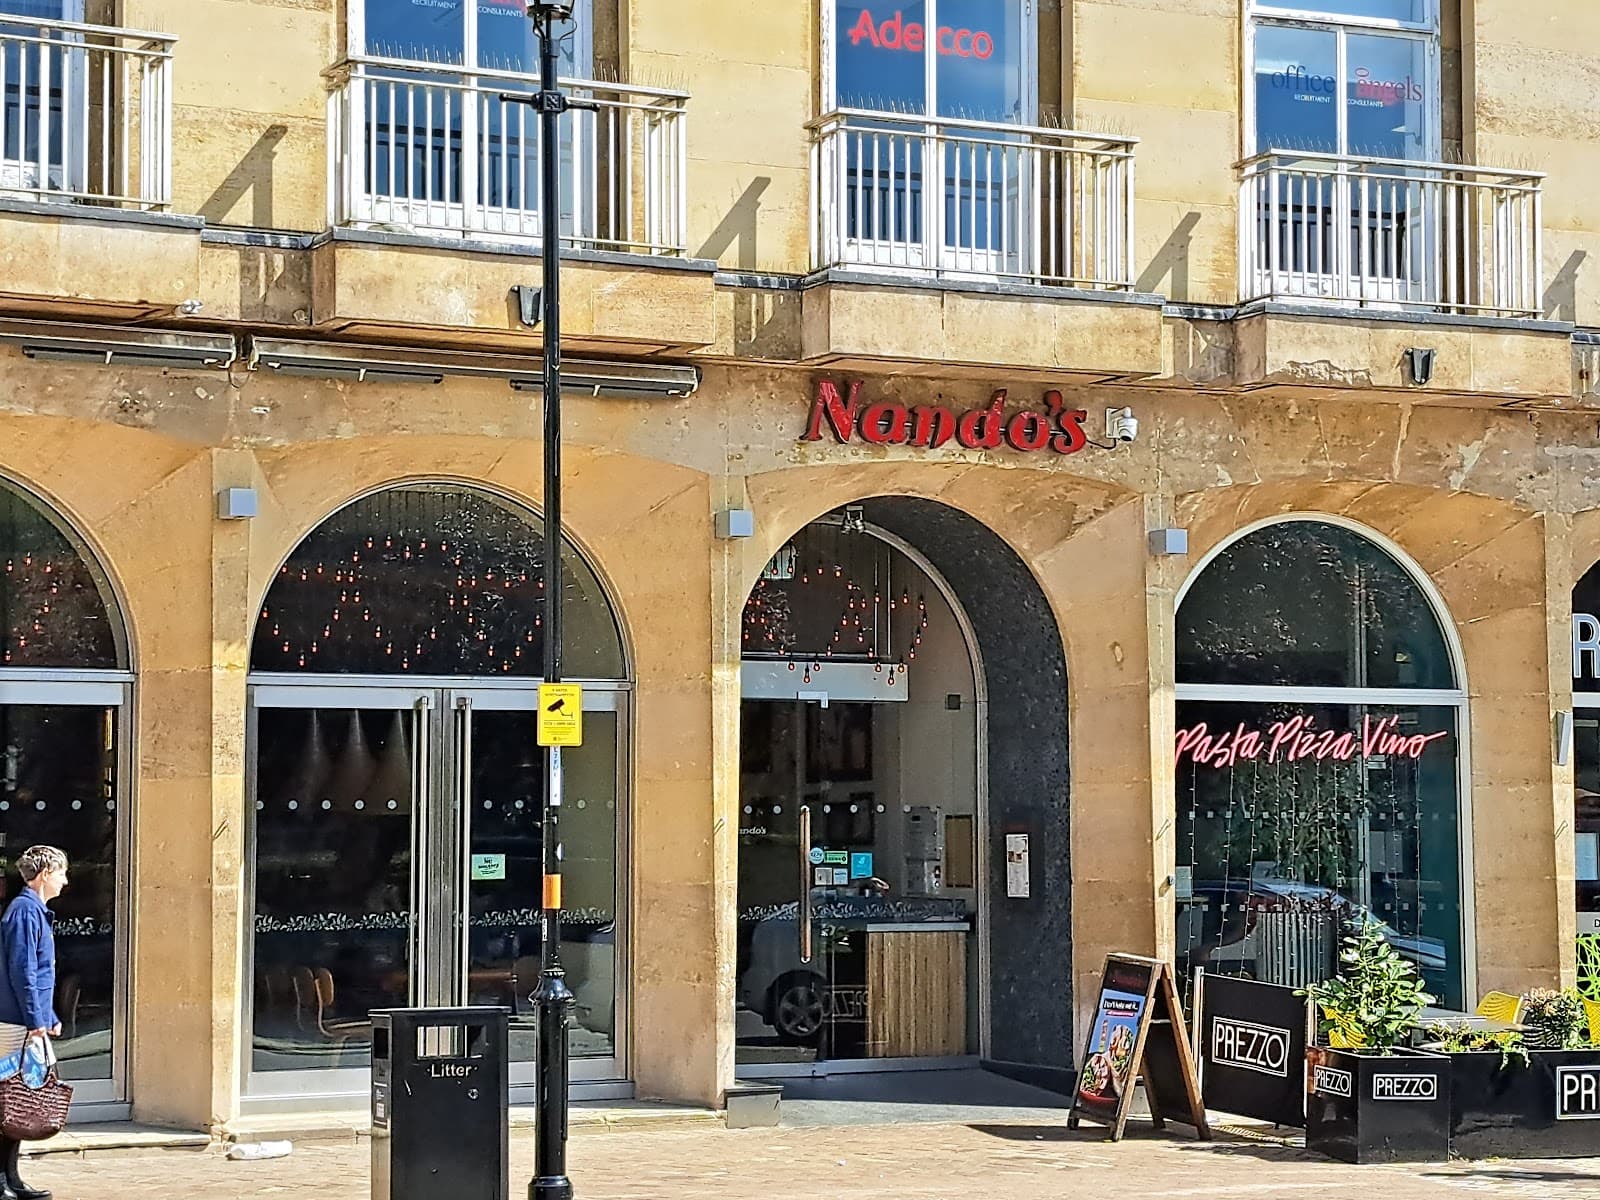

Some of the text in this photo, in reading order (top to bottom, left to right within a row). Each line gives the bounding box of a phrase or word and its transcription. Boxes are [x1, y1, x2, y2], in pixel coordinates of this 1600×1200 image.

[478, 6, 522, 18] CONSULTANTS
[847, 9, 993, 60] Adecco
[1271, 64, 1423, 103] office angels
[800, 379, 1088, 454] Nando's
[1175, 714, 1448, 768] Pasta Pizza Vino
[1215, 1023, 1285, 1068] PREZZO
[431, 1064, 472, 1077] Litter
[1316, 1070, 1350, 1092] PREZZO
[1376, 1078, 1434, 1096] PREZZO
